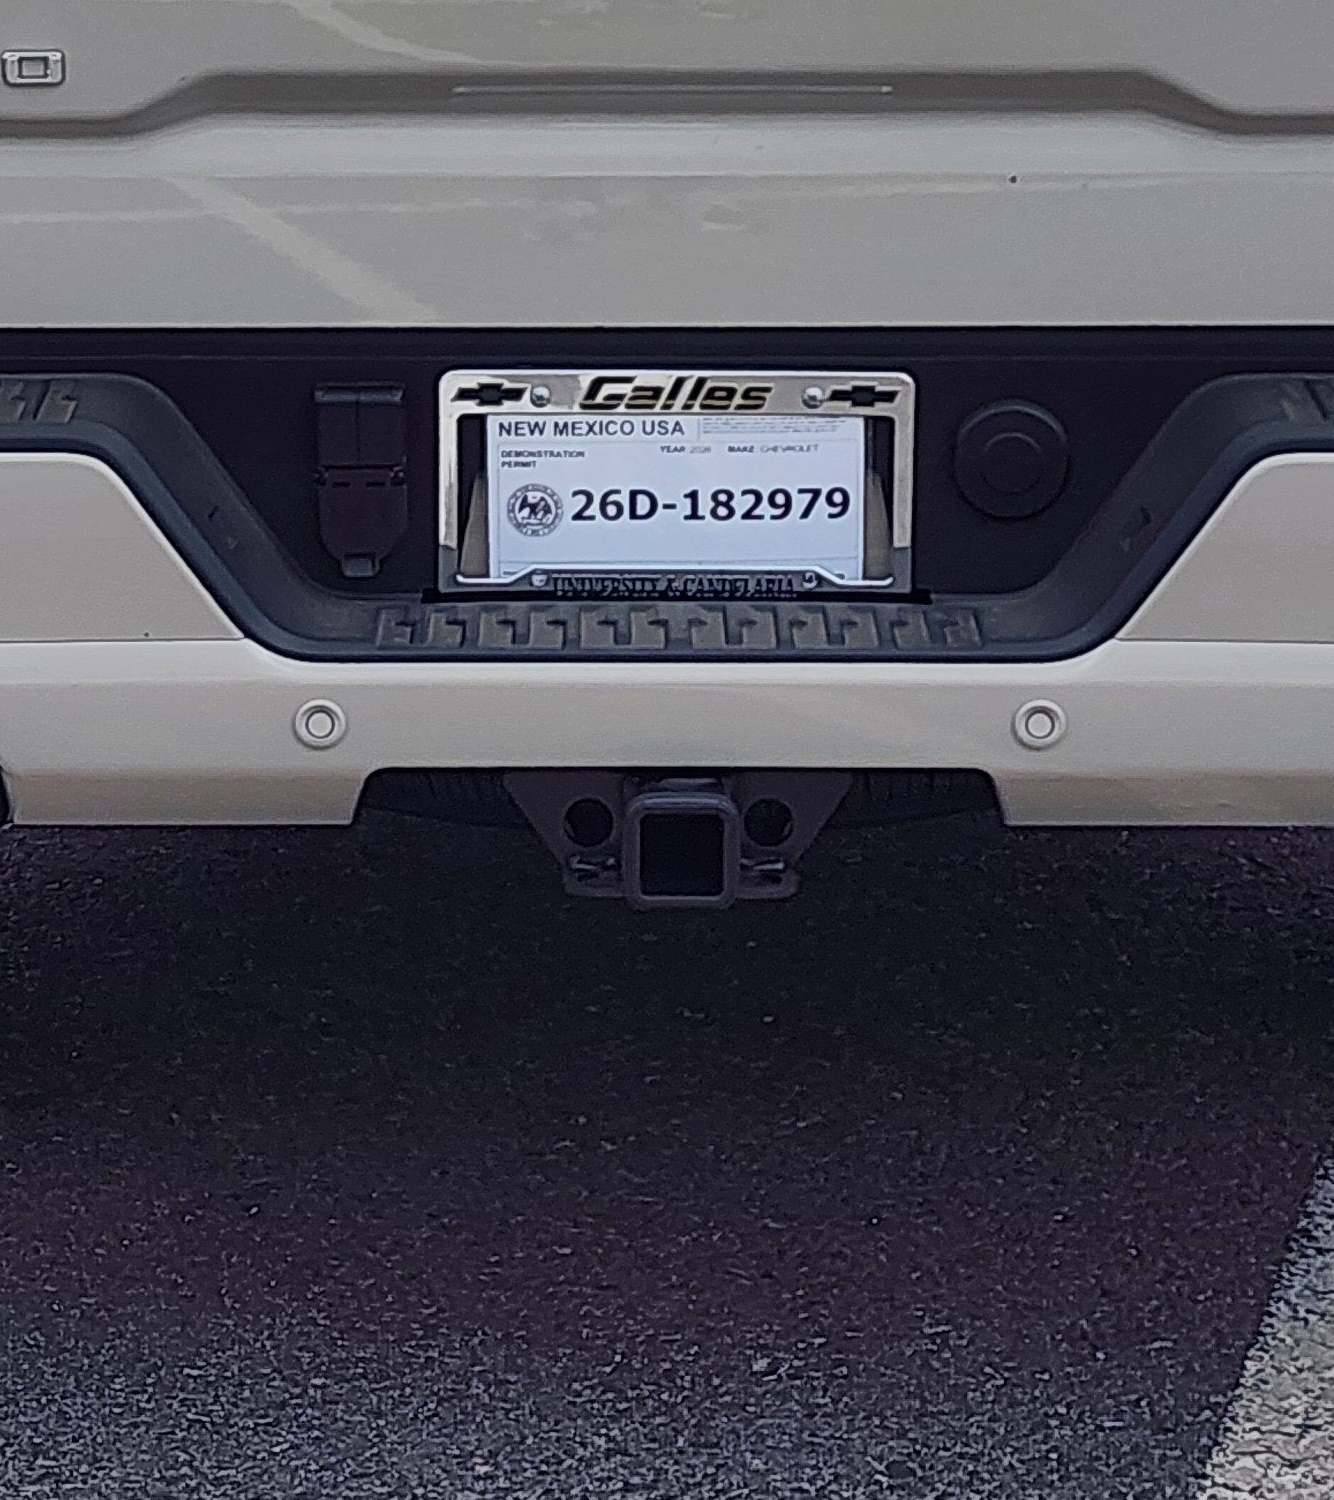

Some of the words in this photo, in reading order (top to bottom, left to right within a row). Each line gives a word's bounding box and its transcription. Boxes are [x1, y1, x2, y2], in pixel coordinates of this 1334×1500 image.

[578, 376, 774, 411] Galles
[498, 421, 547, 437] NEW
[553, 420, 635, 437] MEXICO
[641, 419, 685, 436] USA
[660, 445, 686, 454] YEAR
[760, 444, 820, 453] CHEVROLET
[500, 450, 586, 458] DEMONSTRATION
[500, 460, 537, 468] PERMIT
[570, 487, 851, 521] 26D-182979
